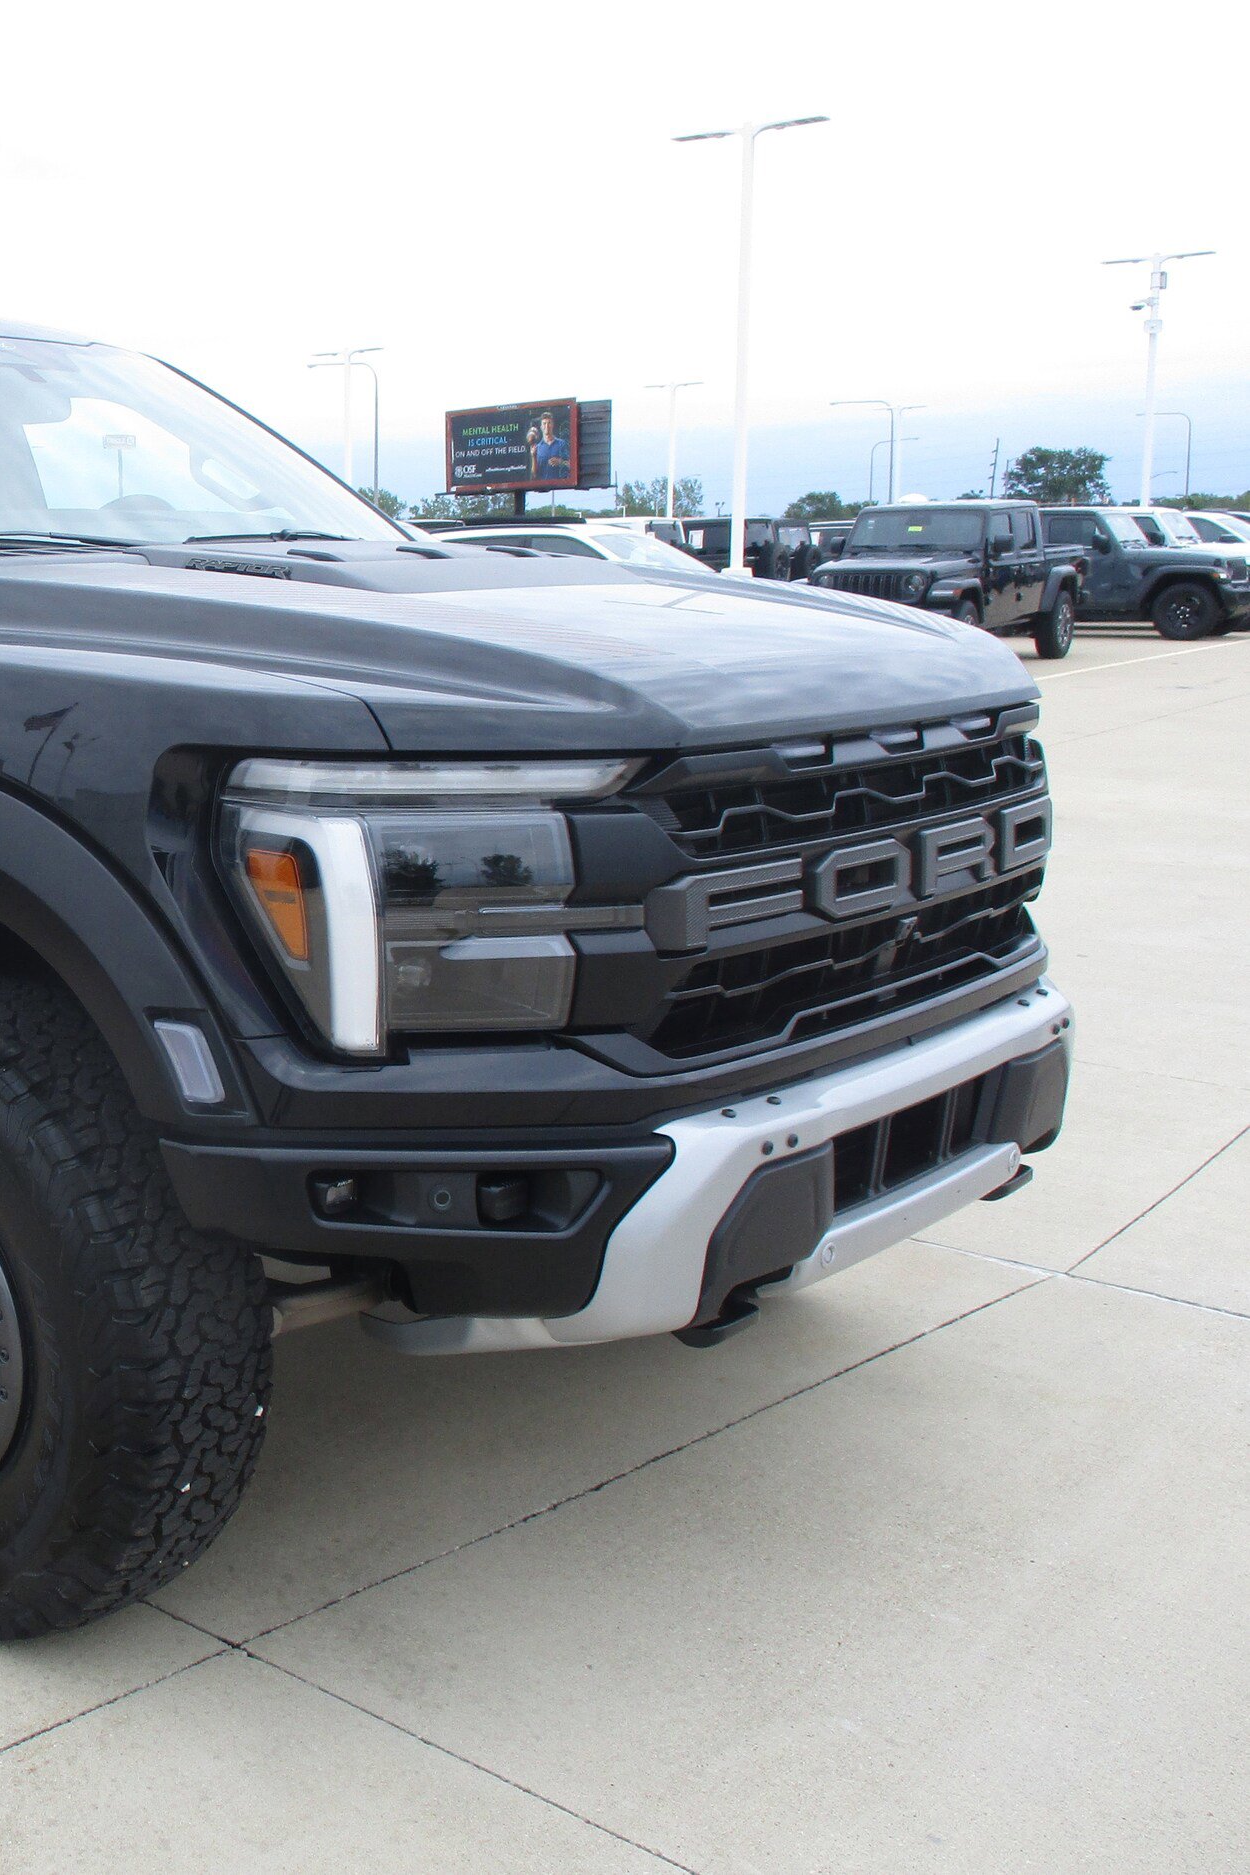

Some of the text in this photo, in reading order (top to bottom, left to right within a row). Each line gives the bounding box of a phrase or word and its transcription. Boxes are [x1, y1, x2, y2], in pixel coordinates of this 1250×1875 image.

[462, 424, 519, 436] MENTAL HEALTH
[468, 439, 475, 447] IS
[475, 436, 508, 446] CRITICAL
[481, 447, 493, 456] OFF
[495, 447, 507, 455] THE
[463, 464, 477, 474] OSF
[186, 557, 292, 579] RAPTOR
[683, 798, 1051, 950] FORD
